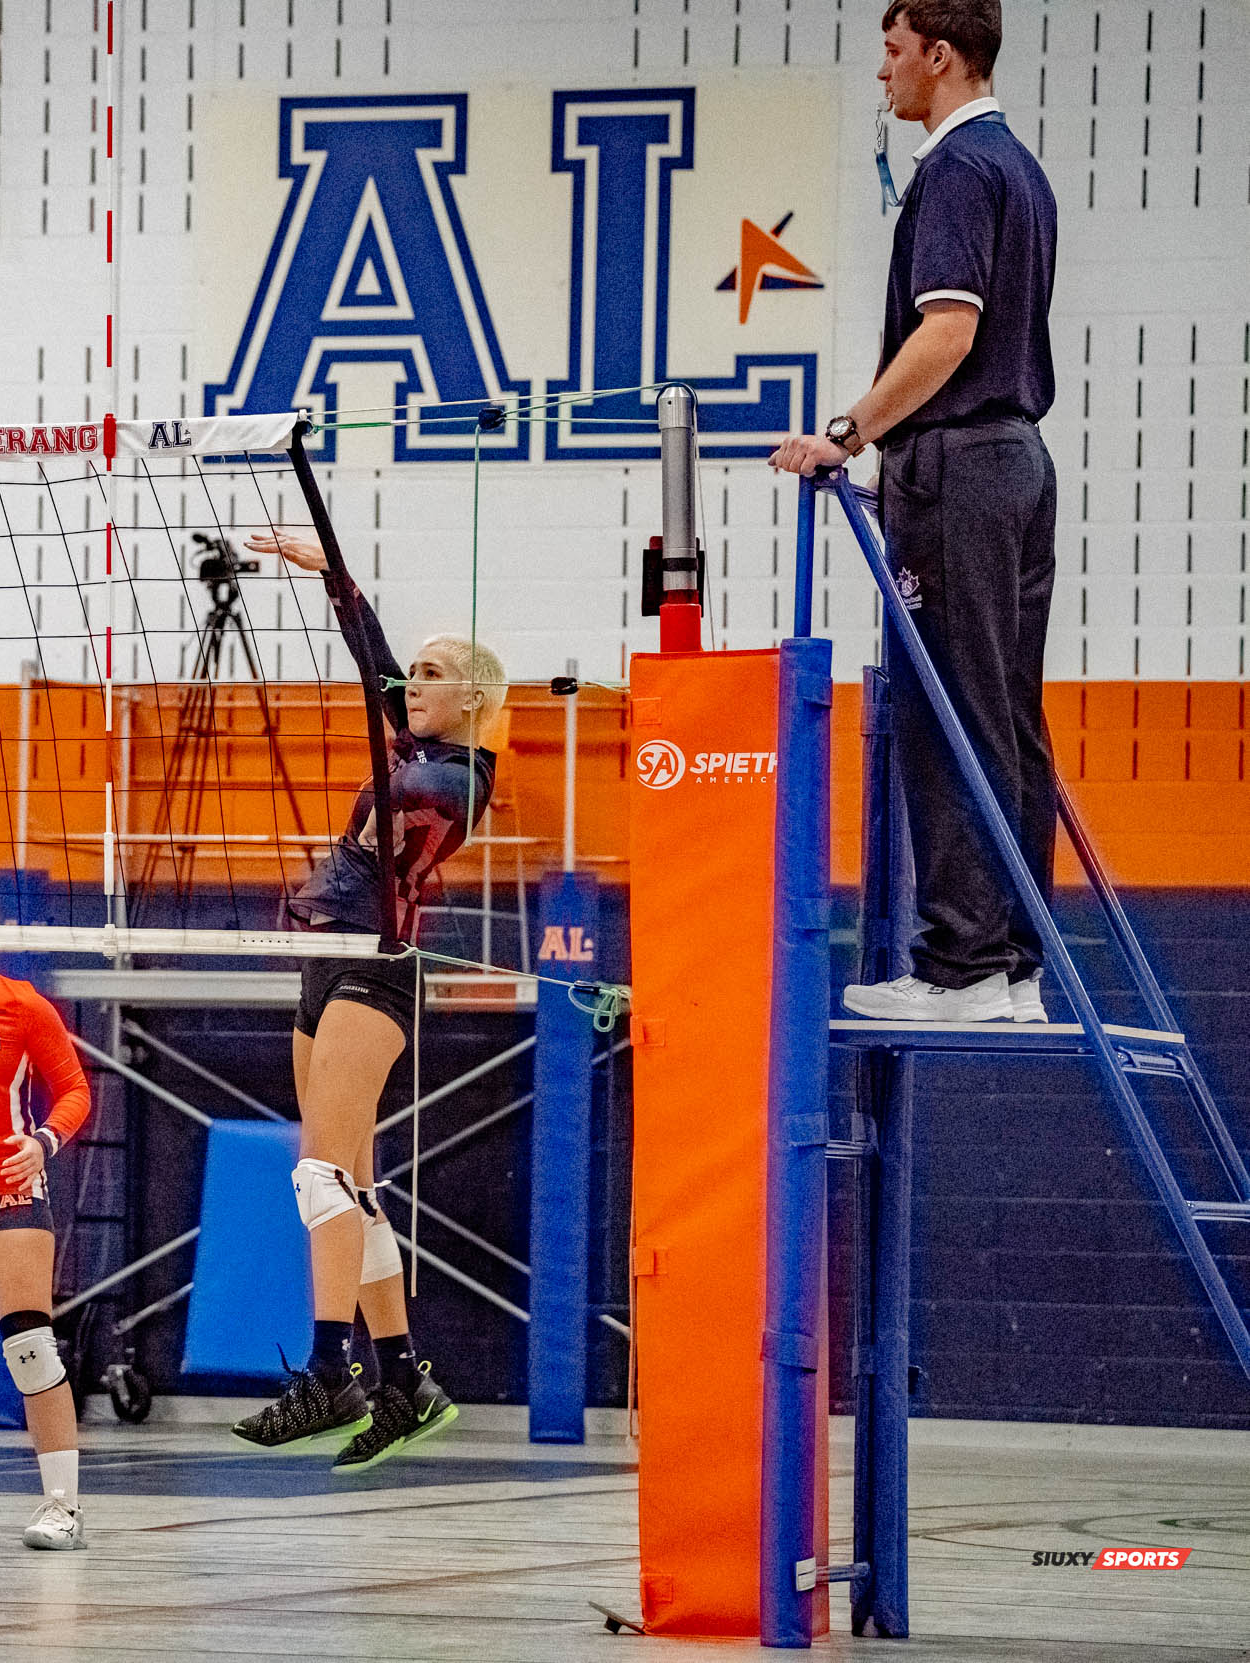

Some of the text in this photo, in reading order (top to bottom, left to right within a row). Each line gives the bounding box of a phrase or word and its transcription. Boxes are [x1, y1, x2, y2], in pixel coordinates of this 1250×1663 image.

[203, 86, 817, 463] AL
[148, 421, 191, 449] AL
[696, 776, 778, 784] AMERIC
[538, 926, 593, 961] AL
